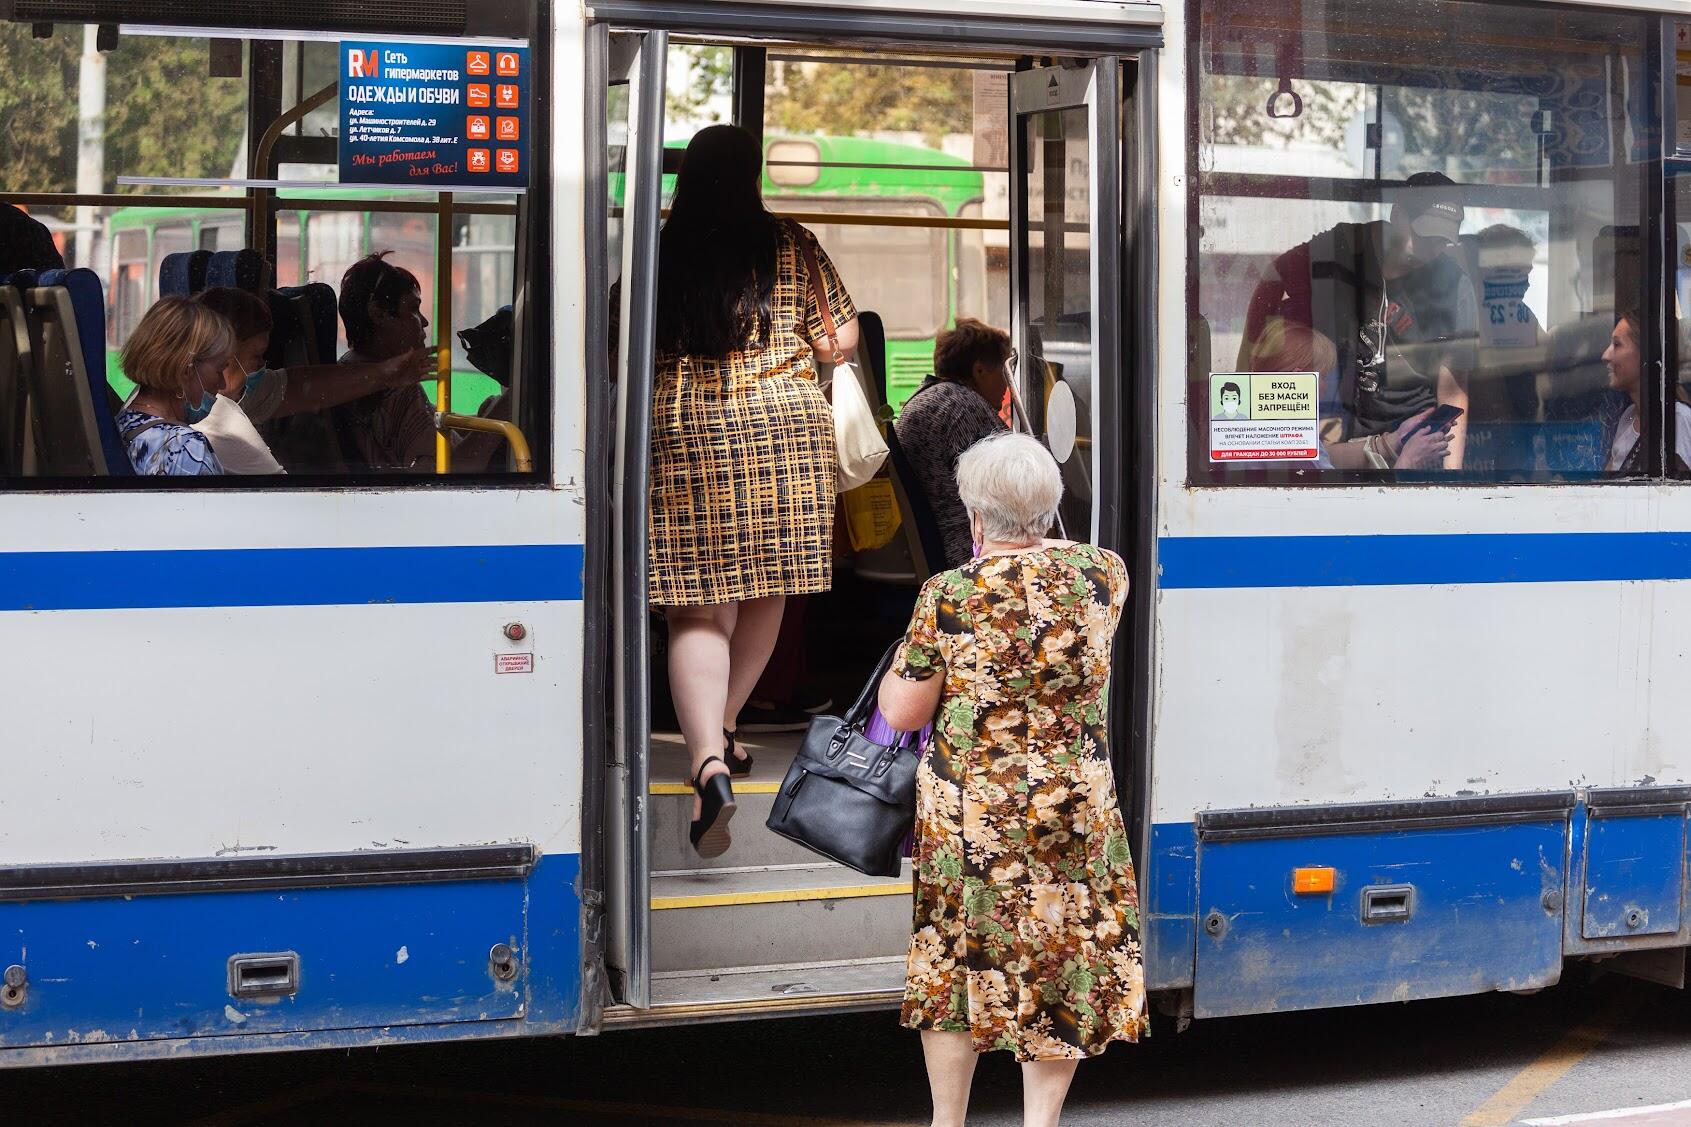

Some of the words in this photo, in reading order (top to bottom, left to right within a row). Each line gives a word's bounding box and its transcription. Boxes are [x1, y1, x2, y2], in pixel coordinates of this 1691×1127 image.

[384, 50, 408, 64] Сеть
[348, 49, 379, 78] RM
[384, 68, 459, 82] гипермаркетов
[349, 85, 406, 104] ОДЕЖДЫ
[408, 87, 417, 103] И
[419, 88, 460, 104] ОБУВИ
[349, 108, 374, 116] Адреса:
[359, 117, 421, 126] Машиностроителей
[359, 126, 389, 134] Летчиков
[349, 135, 359, 143] ул.
[389, 135, 424, 143] Комсомола
[352, 154, 375, 166] Мы
[378, 149, 437, 167] работаем
[409, 164, 430, 176] для
[432, 161, 458, 174] Вас!
[1271, 382, 1296, 390] ВХОД
[1258, 393, 1275, 401] БЕЗ
[1277, 392, 1309, 400] МАСКИ
[1258, 401, 1310, 412] ЗАПРЕЩЁН!
